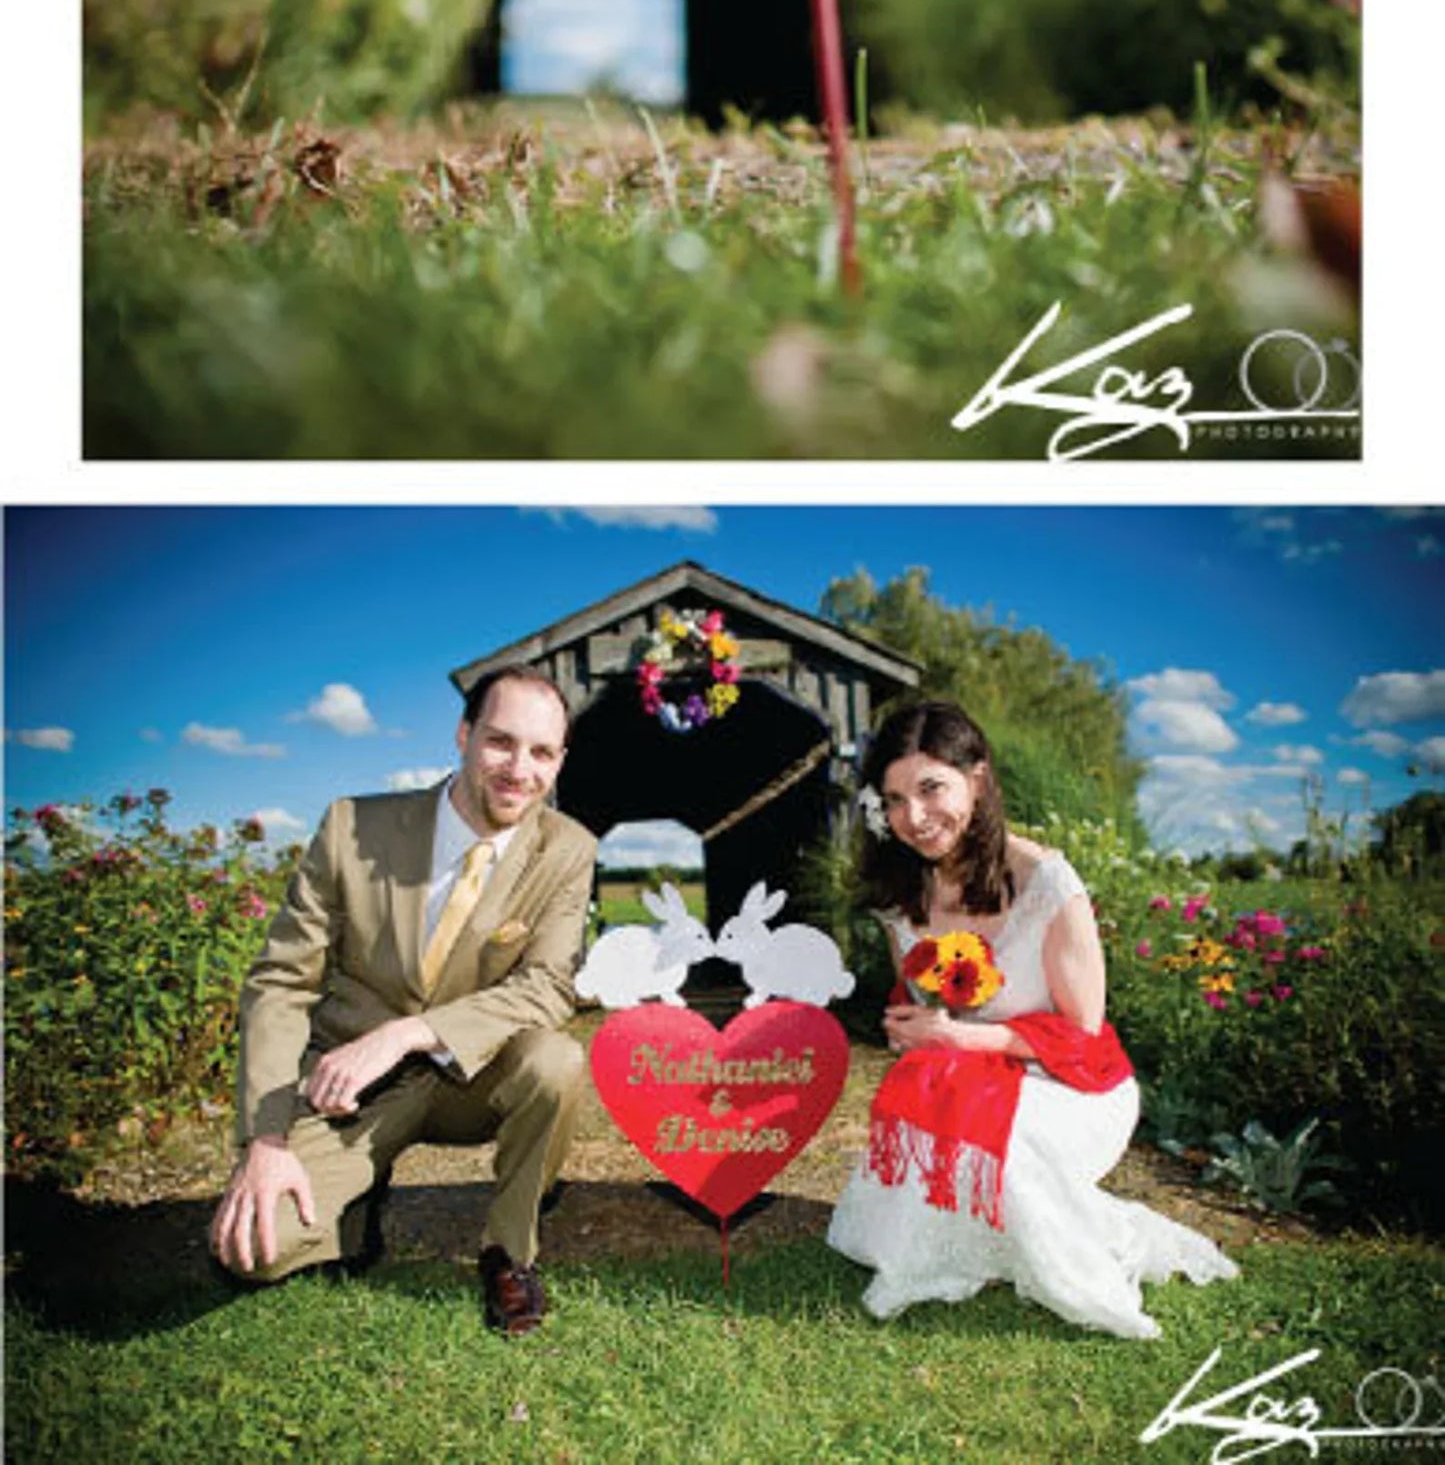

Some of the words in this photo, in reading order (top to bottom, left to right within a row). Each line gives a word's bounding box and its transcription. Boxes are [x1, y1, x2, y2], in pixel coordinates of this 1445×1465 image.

[627, 1042, 815, 1084] Nathaniel
[708, 1089, 734, 1117] &
[654, 1114, 791, 1154] Denise
